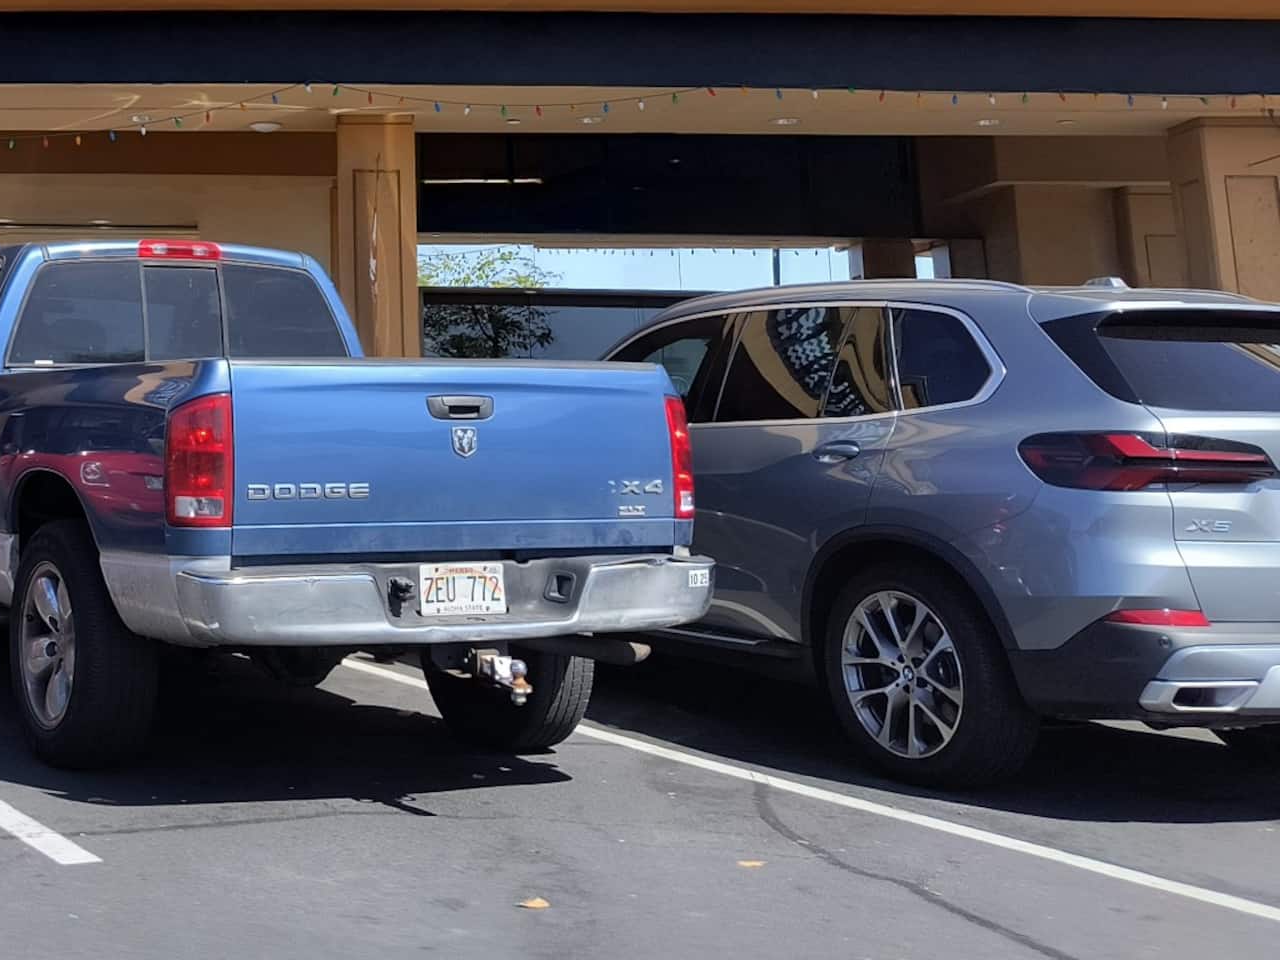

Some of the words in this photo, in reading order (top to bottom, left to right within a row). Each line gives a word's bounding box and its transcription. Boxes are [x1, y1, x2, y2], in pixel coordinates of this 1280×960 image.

[247, 483, 369, 500] DODGE
[1184, 519, 1232, 533] X5
[423, 576, 456, 604] ZEU
[466, 575, 502, 602] 772
